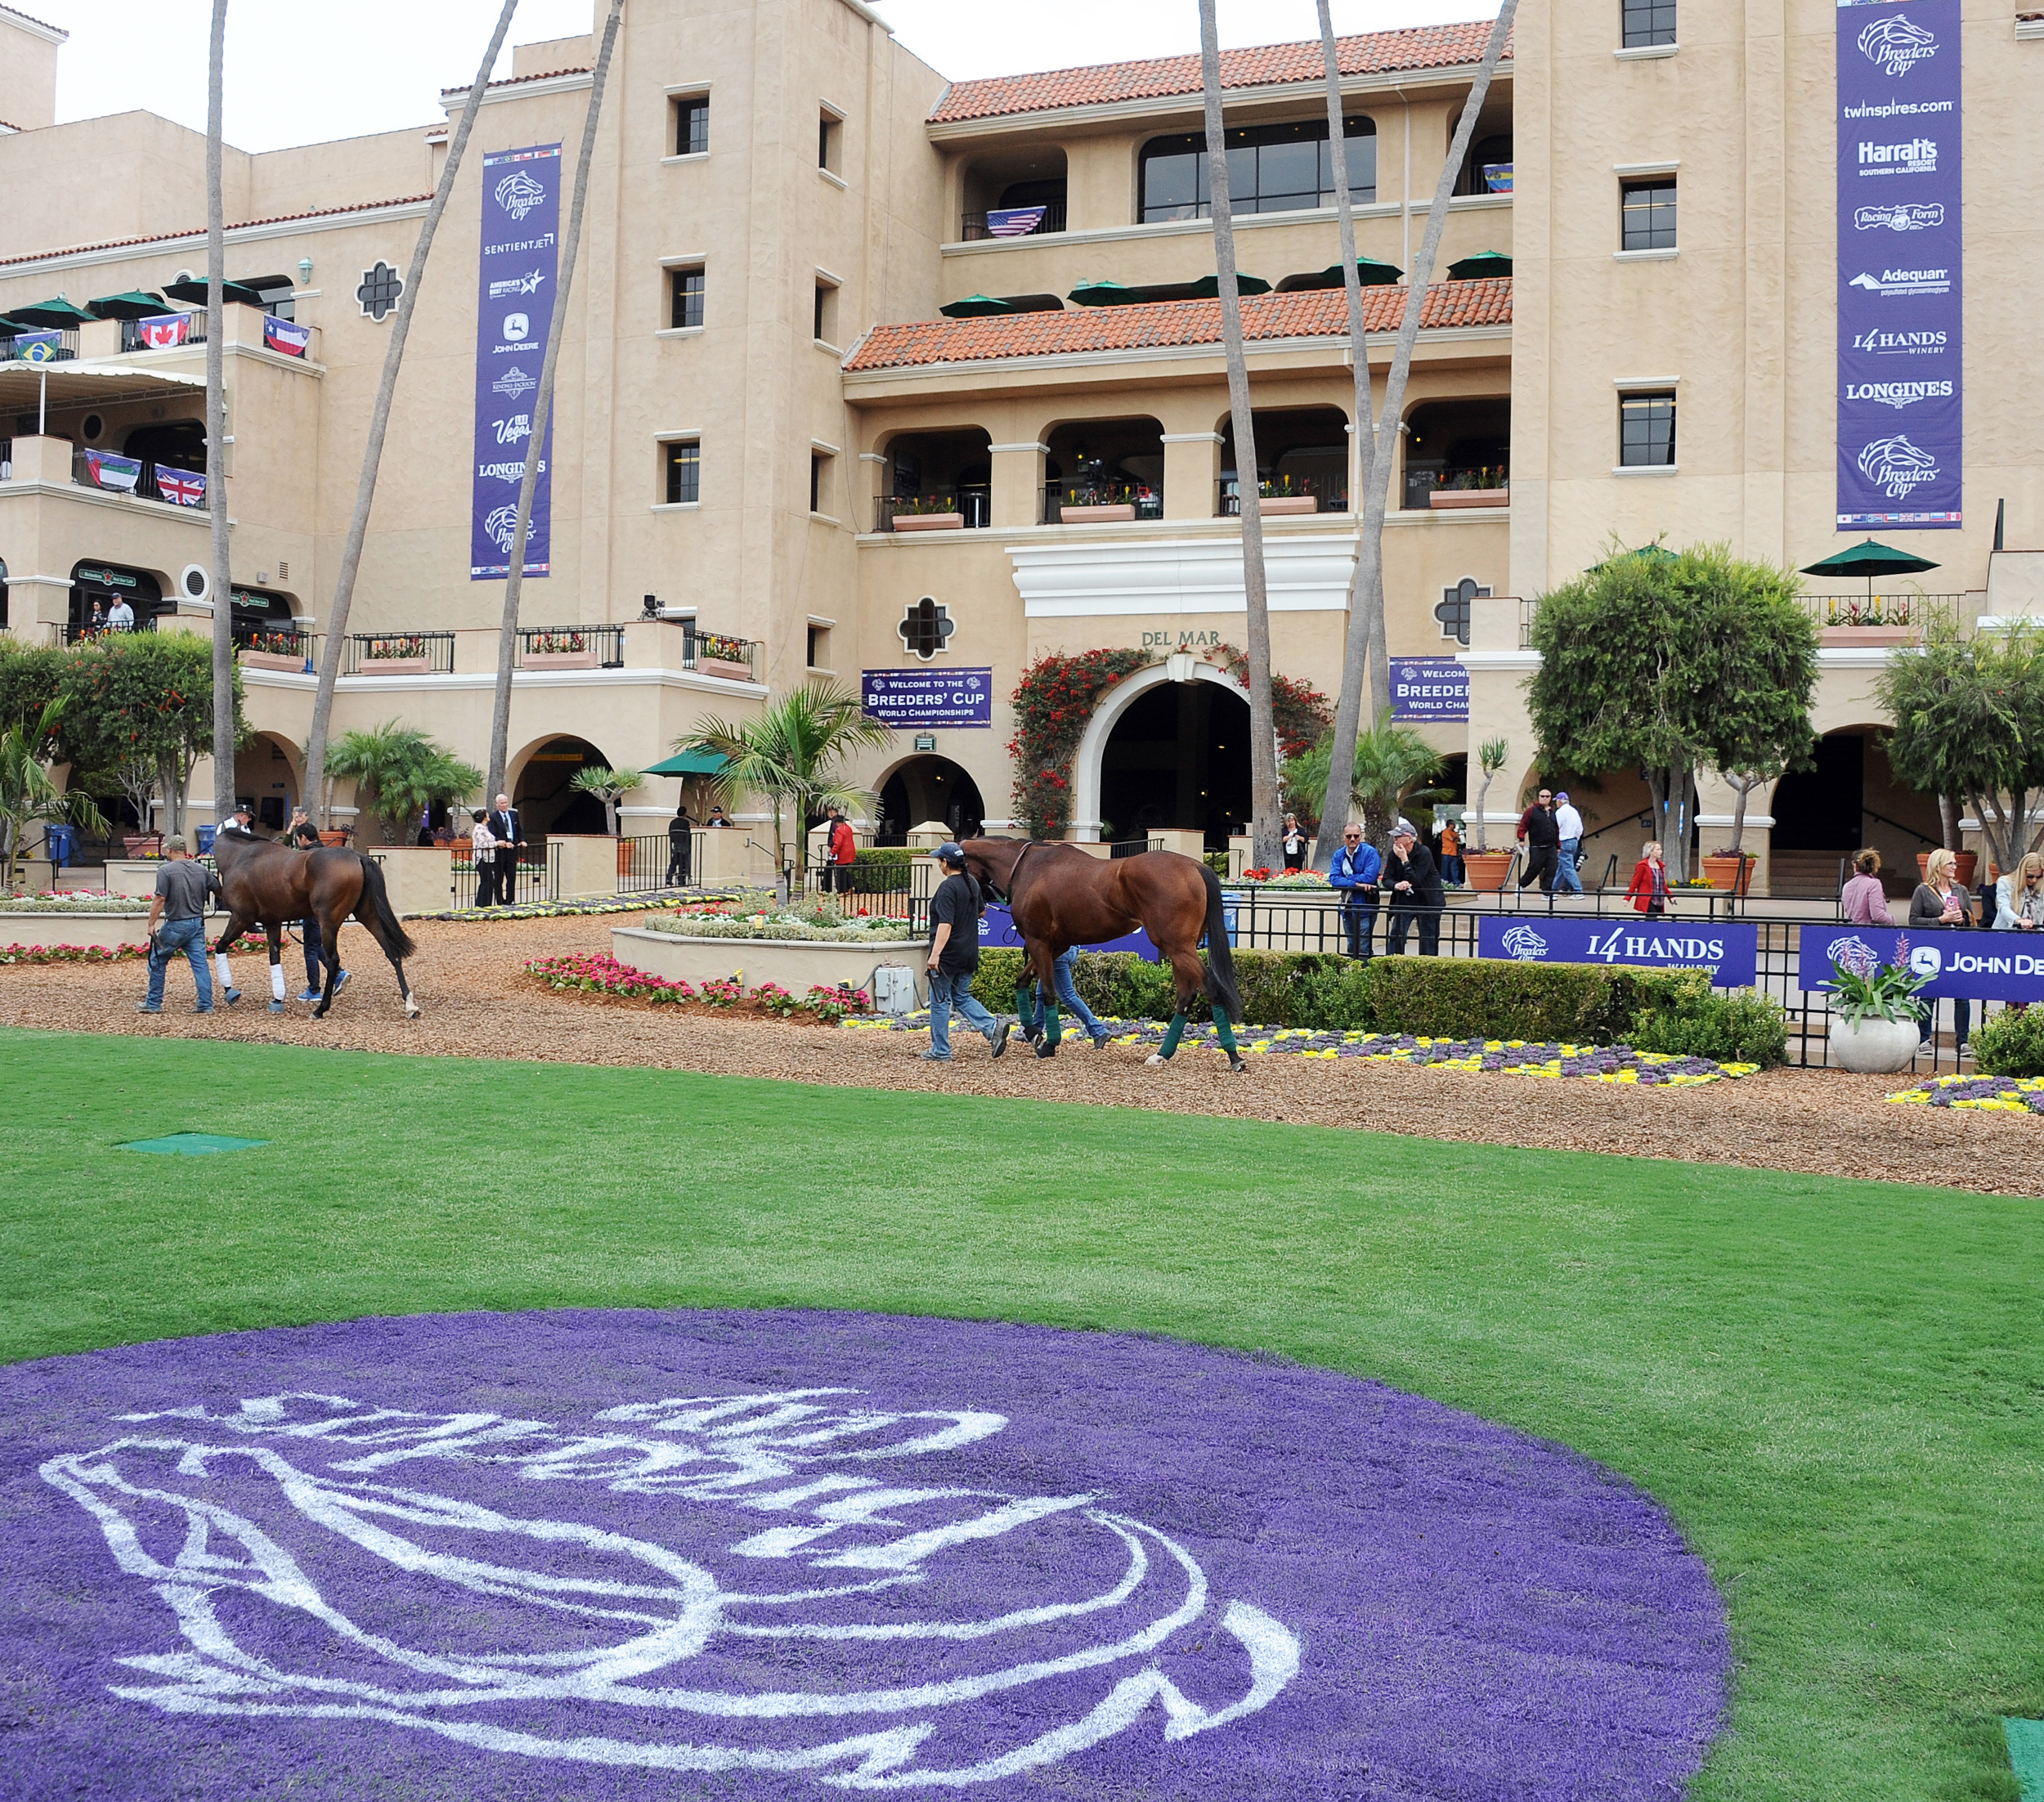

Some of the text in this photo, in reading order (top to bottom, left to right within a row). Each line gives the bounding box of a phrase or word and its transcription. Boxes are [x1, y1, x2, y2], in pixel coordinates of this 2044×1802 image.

[1875, 43, 1939, 65] Breeders'
[1885, 59, 1913, 77] Cup
[1843, 96, 1953, 119] twinspires.com
[1858, 138, 1938, 164] Harrah's
[1858, 165, 1936, 177] SOUTHERN CALIFORNIA
[1907, 159, 1936, 167] RESORT
[511, 207, 531, 221] Cup
[1860, 208, 1938, 222] Racing Form
[1881, 268, 1945, 282] Adequan
[492, 342, 539, 353] JOHN DEERE
[1852, 328, 1947, 352] 14 HANDS
[1908, 347, 1945, 355] WINERY
[1846, 381, 1953, 400] LONGINES
[491, 417, 532, 445] Vegas
[478, 460, 546, 477] LONGINS
[1875, 464, 1940, 486] Breeders'
[1885, 482, 1914, 500] Cup
[1142, 630, 1220, 646] DEL MAR
[889, 680, 931, 688] WELCOME
[867, 692, 985, 706] BREEDERS' CUP
[1409, 701, 1443, 710] WORLD
[878, 709, 975, 717] WORLD CHAMPIONSHIPS
[1586, 926, 1724, 962] 14 HANDS
[1945, 952, 2010, 975] JOHN
